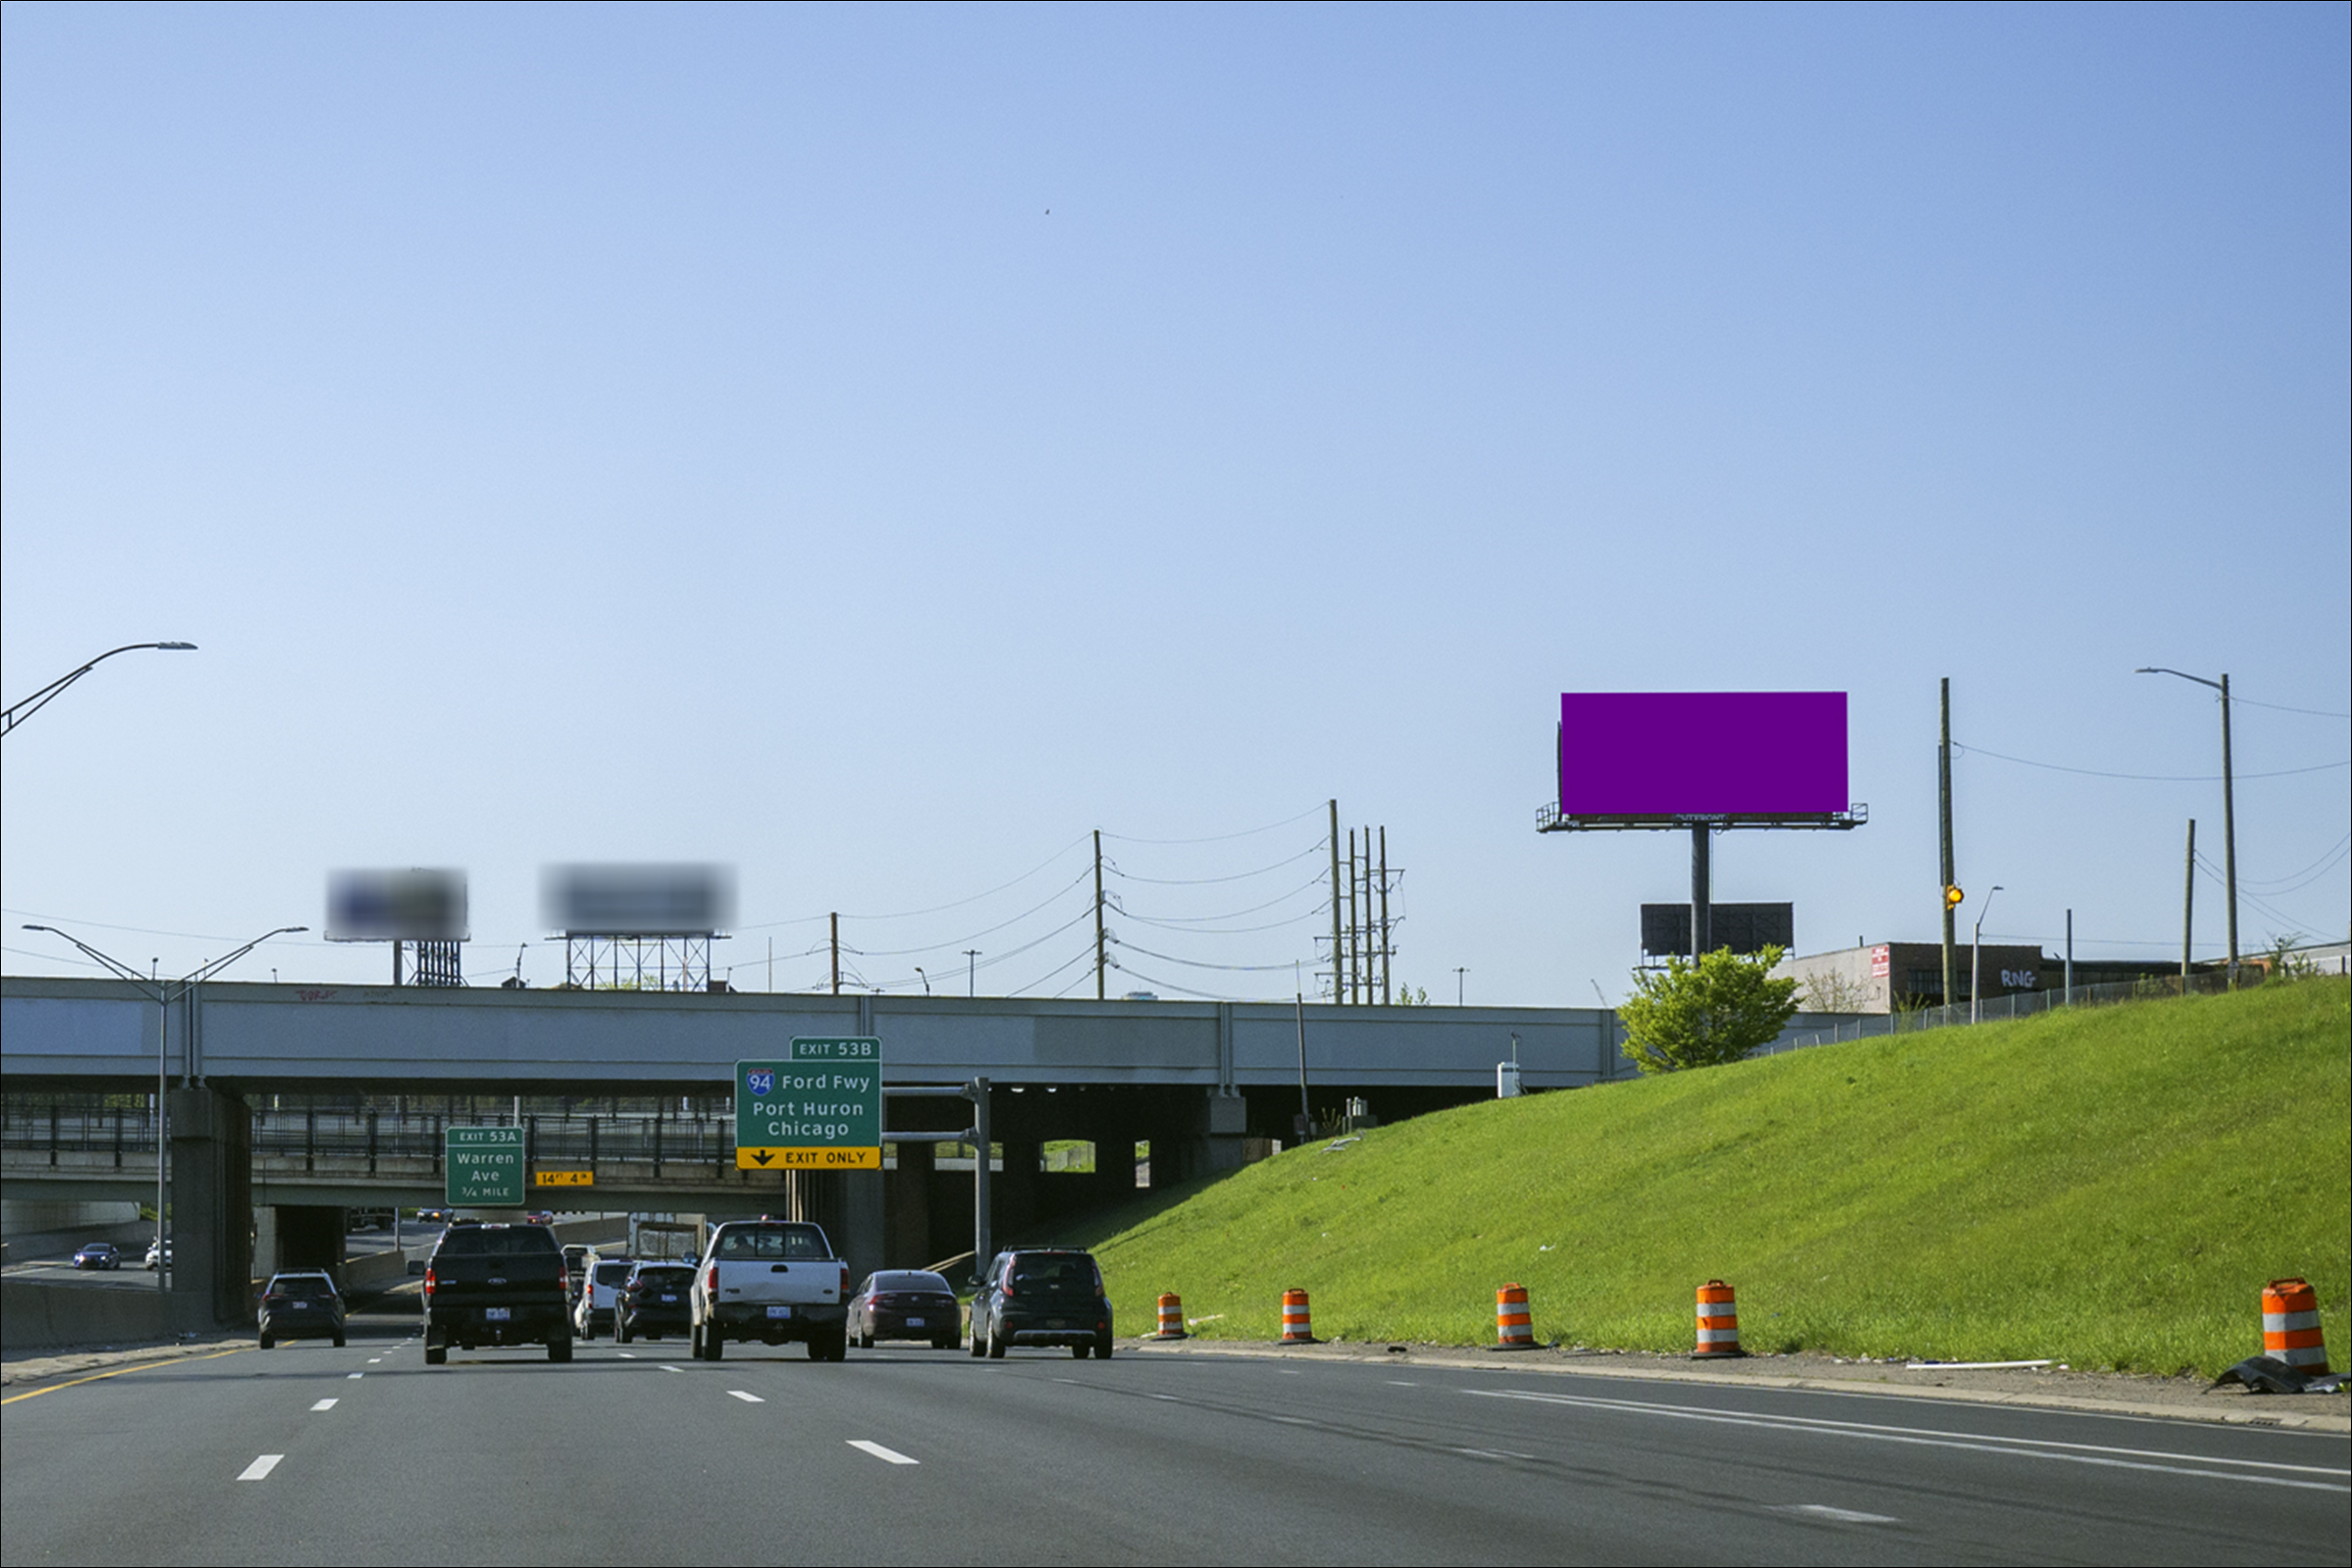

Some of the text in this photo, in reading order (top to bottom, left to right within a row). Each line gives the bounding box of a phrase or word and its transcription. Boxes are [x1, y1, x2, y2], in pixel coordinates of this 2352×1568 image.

[2000, 968, 2036, 988] RNG
[800, 1043, 872, 1055] EXIT 53B
[750, 1075, 870, 1093] 94 Ford Fwy
[753, 1102, 863, 1116] Port Huron
[767, 1121, 850, 1140] Chicago
[460, 1131, 517, 1143] EXIT 53A
[457, 1152, 514, 1164] Warren
[786, 1152, 866, 1164] EXIT ONLY
[471, 1170, 501, 1182] Ave
[483, 1187, 510, 1198] MILE
